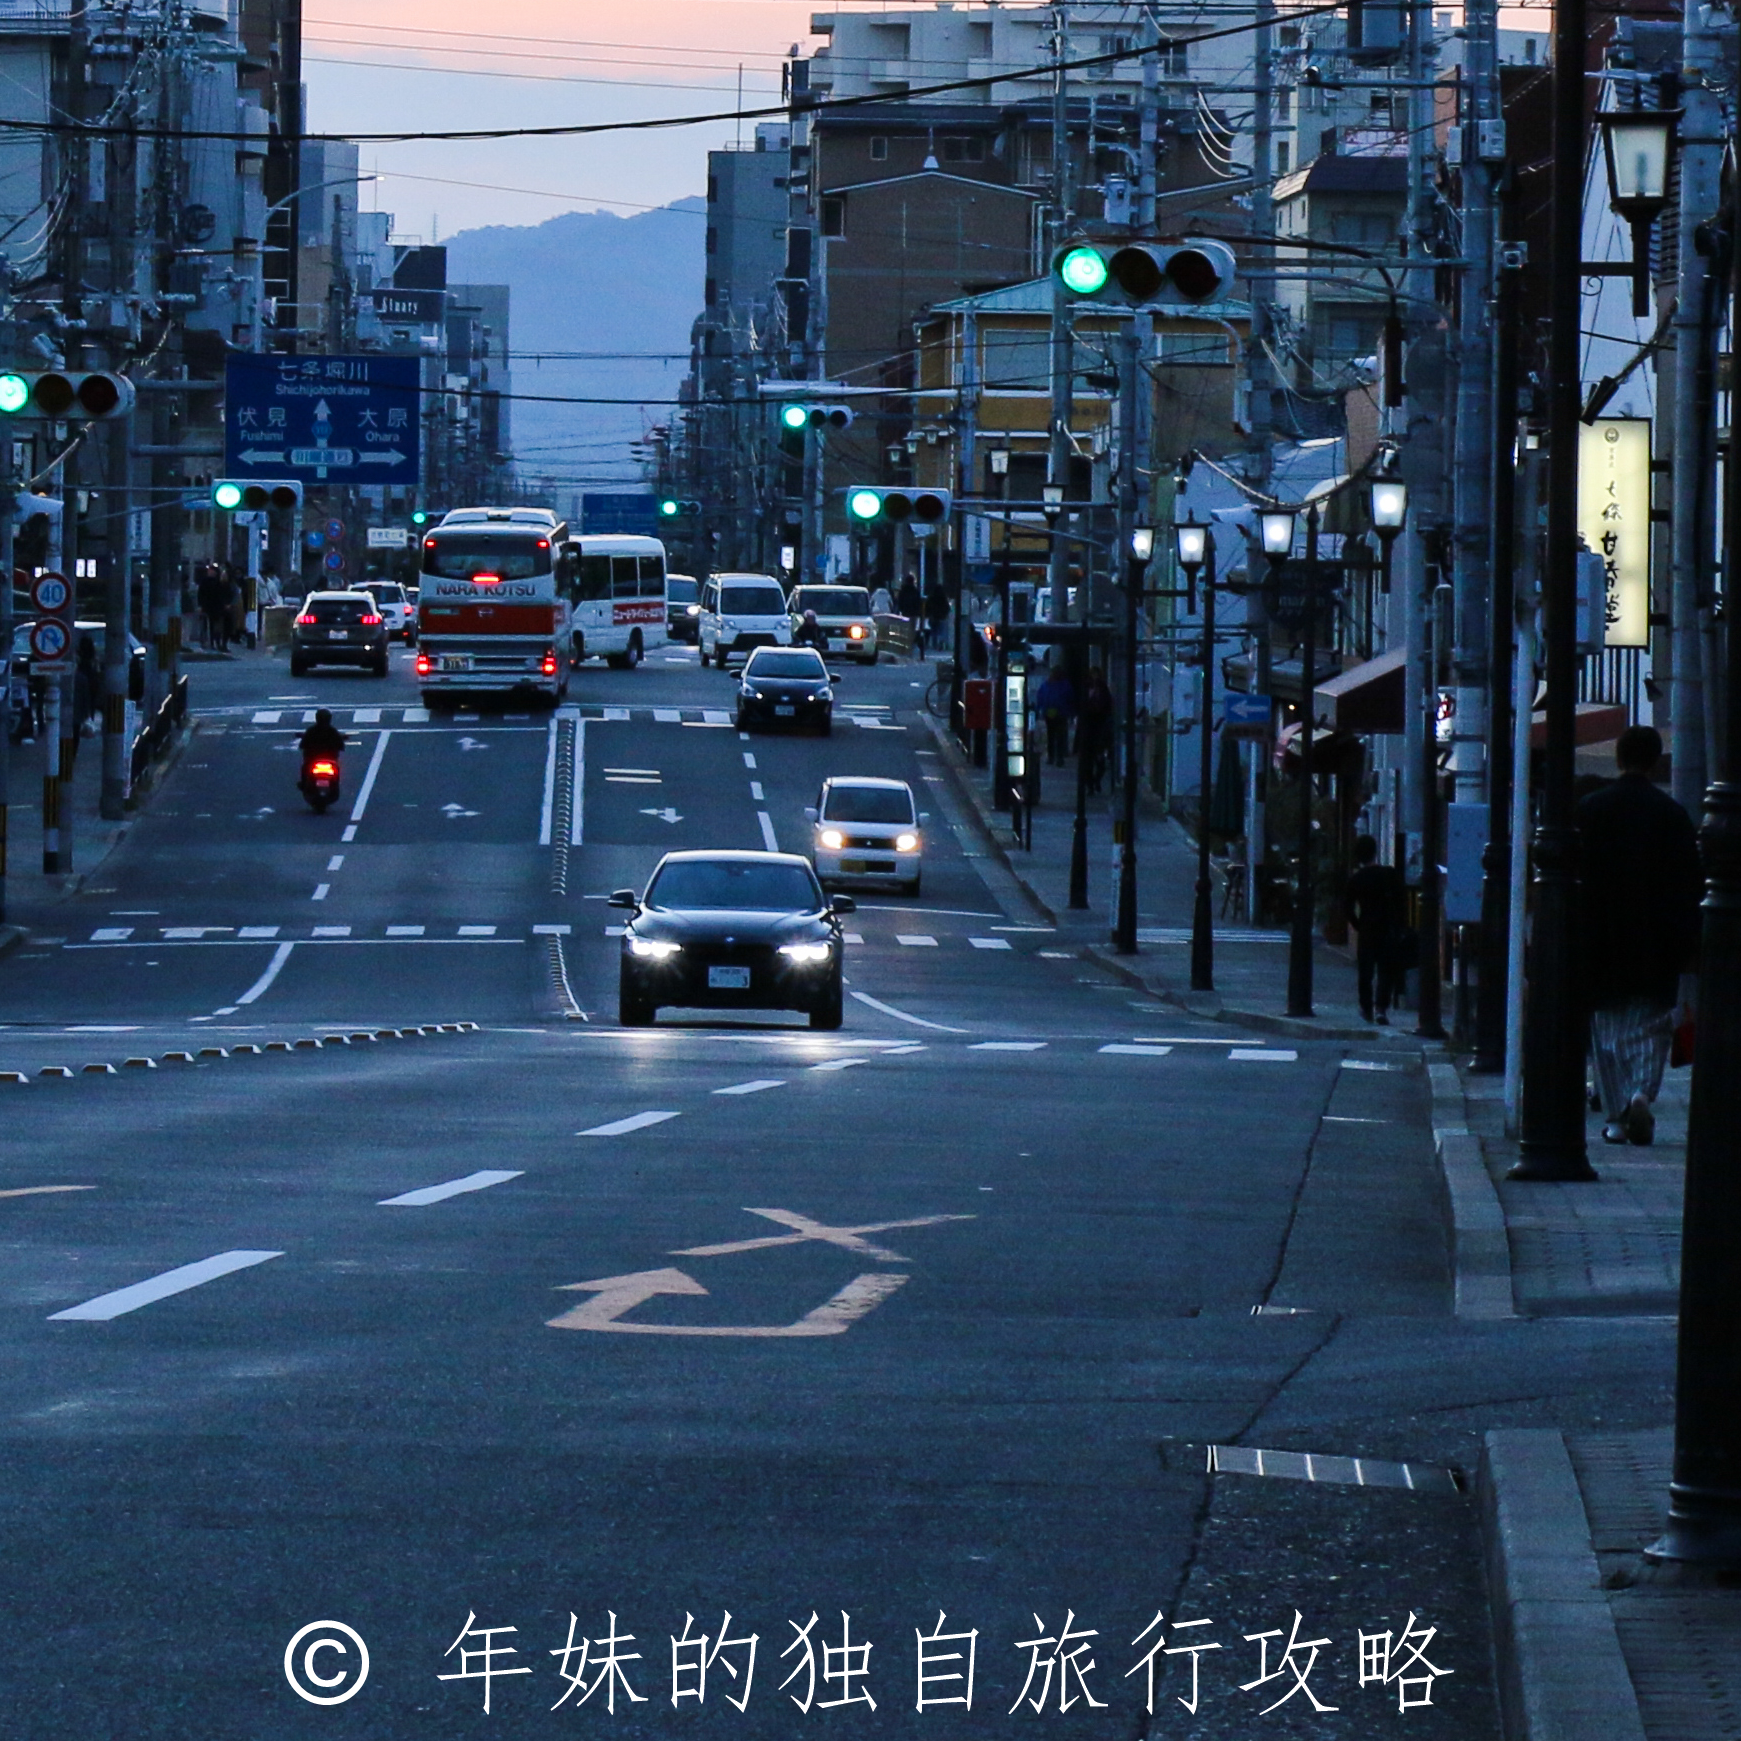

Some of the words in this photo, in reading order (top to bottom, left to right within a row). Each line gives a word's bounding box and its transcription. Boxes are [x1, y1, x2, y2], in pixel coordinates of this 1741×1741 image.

[277, 360, 369, 382] 七条堀川
[275, 383, 370, 398] Shichijohorikawa
[237, 406, 288, 428] 伏見
[357, 407, 408, 428] 大原
[240, 430, 284, 442] Fushimi
[365, 430, 400, 443] Ohara
[41, 584, 63, 603] 40
[436, 584, 478, 596] NARA
[484, 584, 536, 597] KOTSU
